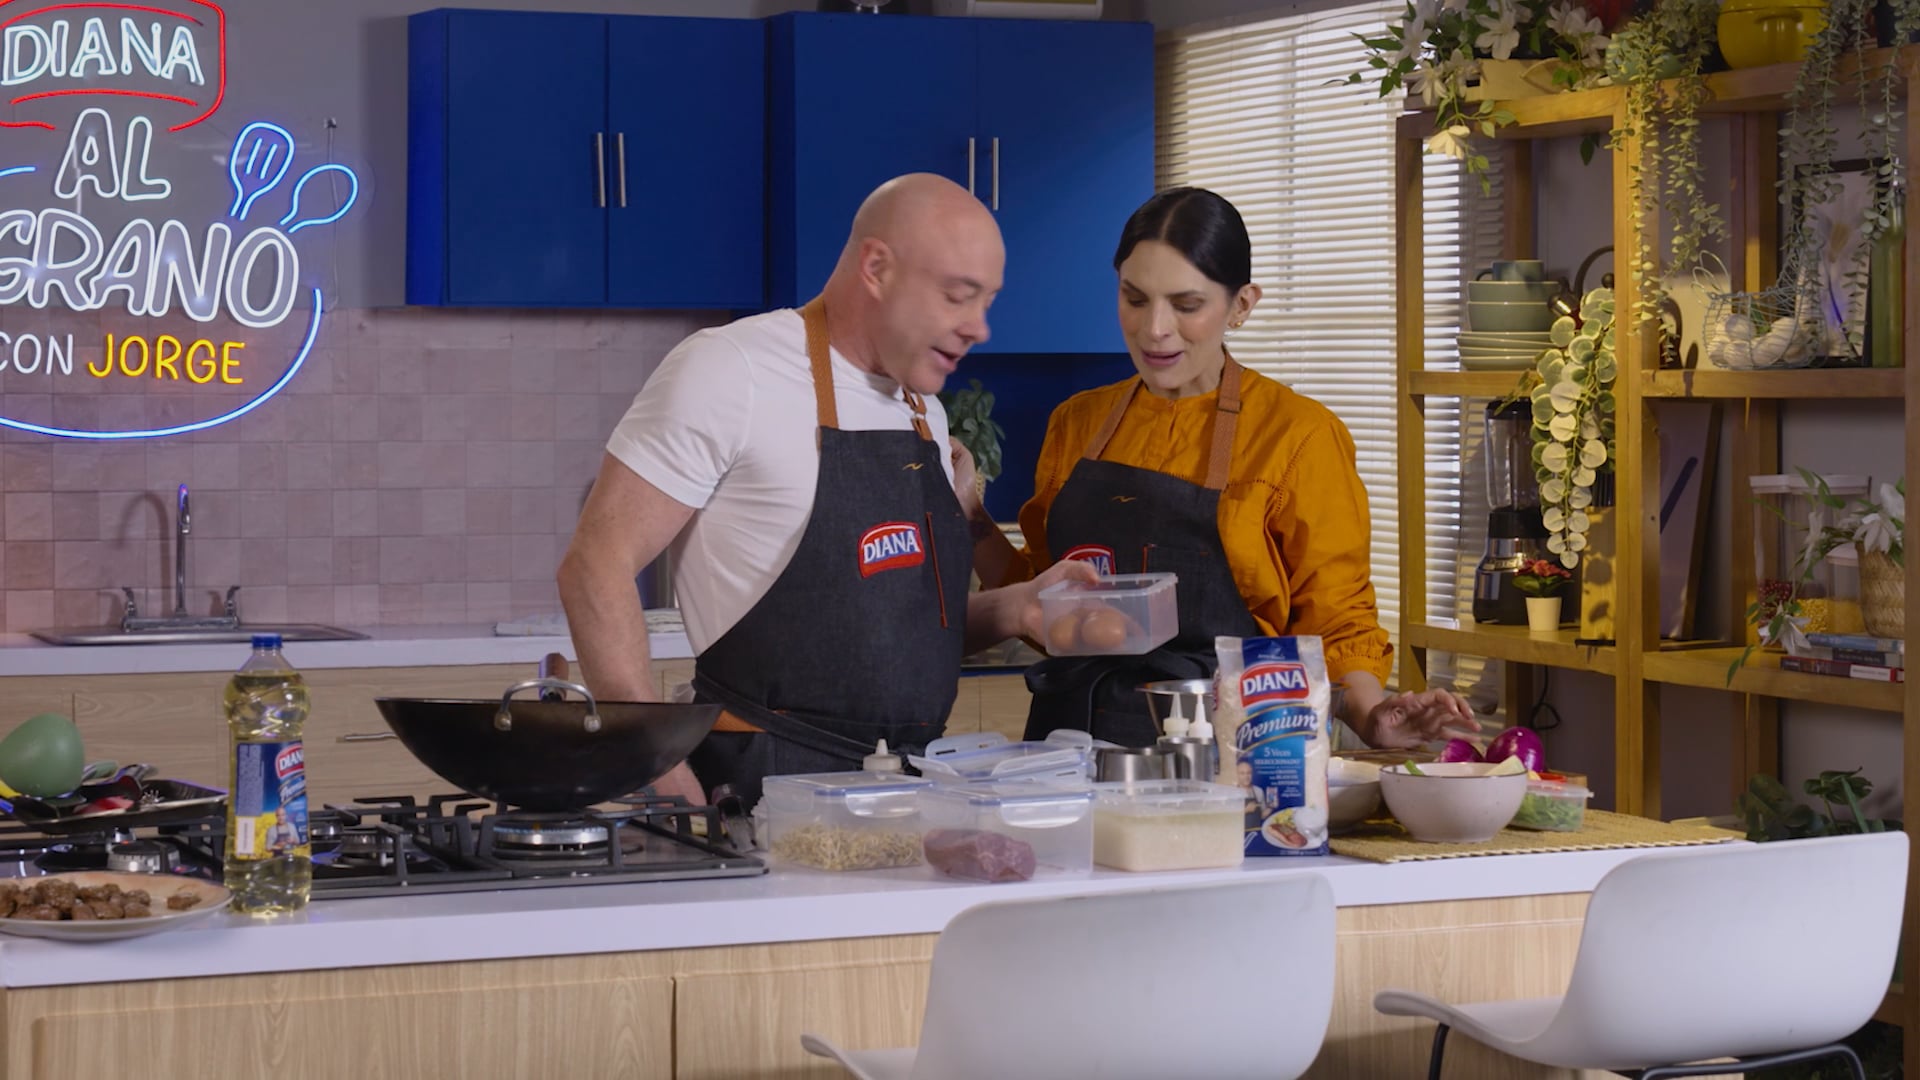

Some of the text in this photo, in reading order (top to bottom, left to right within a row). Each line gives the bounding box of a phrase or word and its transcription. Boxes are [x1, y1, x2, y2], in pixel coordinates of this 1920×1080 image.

[1, 17, 205, 86] DIANA
[54, 107, 172, 201] AL
[0, 207, 300, 329] GRANO
[87, 333, 246, 384] JORGE
[863, 530, 922, 565] DIANA
[1242, 669, 1307, 697] DIANA
[1236, 708, 1318, 751] Premium
